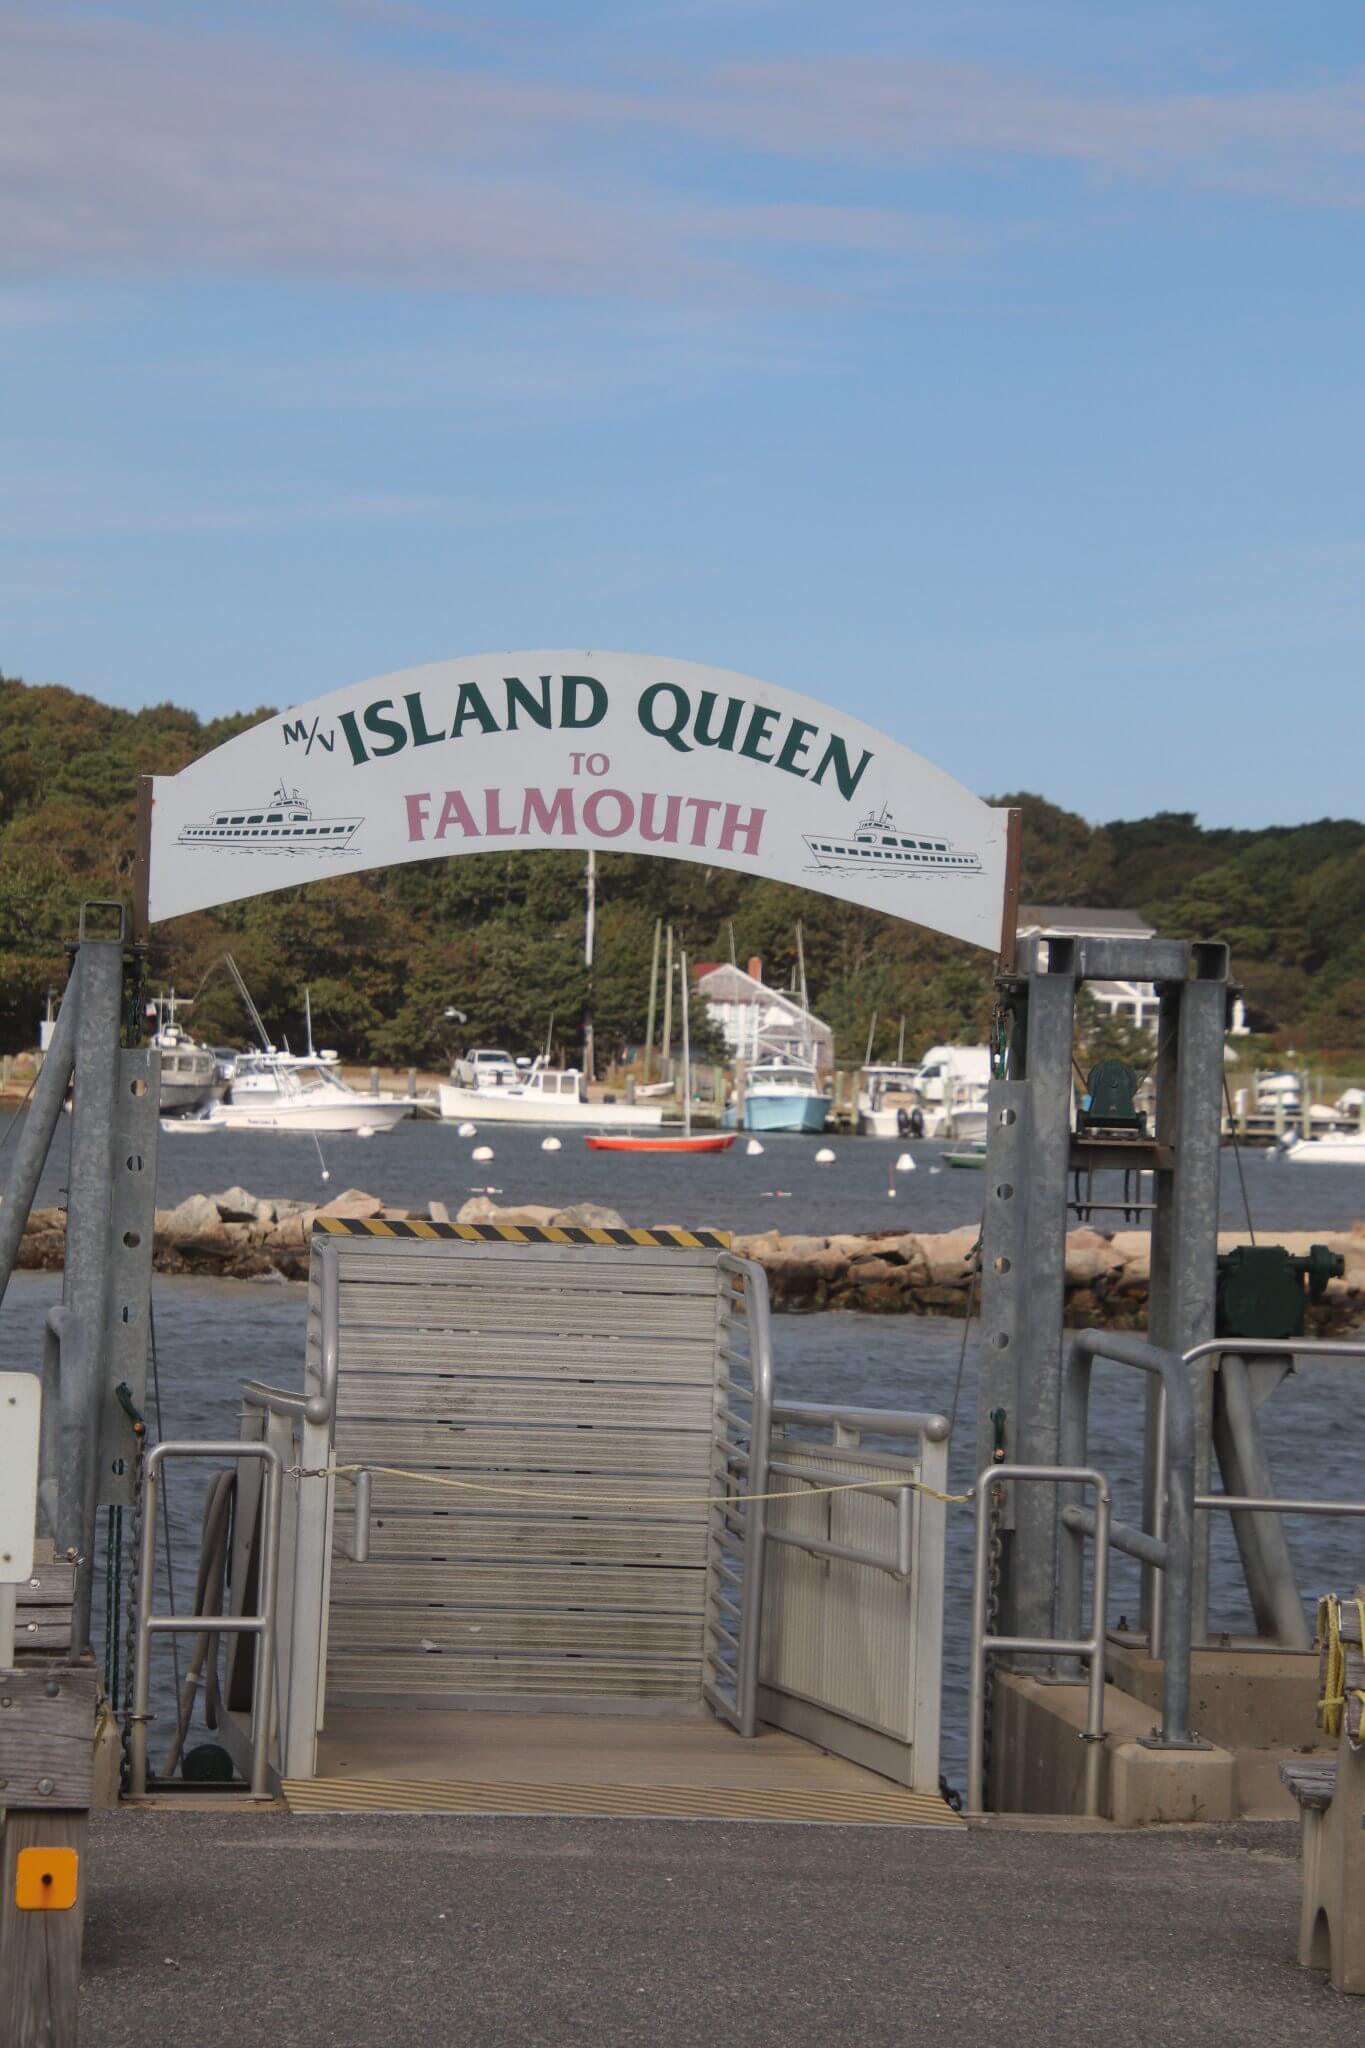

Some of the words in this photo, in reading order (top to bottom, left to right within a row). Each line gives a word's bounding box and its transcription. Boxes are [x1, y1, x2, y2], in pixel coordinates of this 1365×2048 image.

[282, 715, 335, 756] M/V
[337, 675, 609, 767] ISLAND
[638, 682, 875, 803] QUEEN
[569, 752, 609, 776] TO
[403, 787, 767, 856] FALMOUTH
